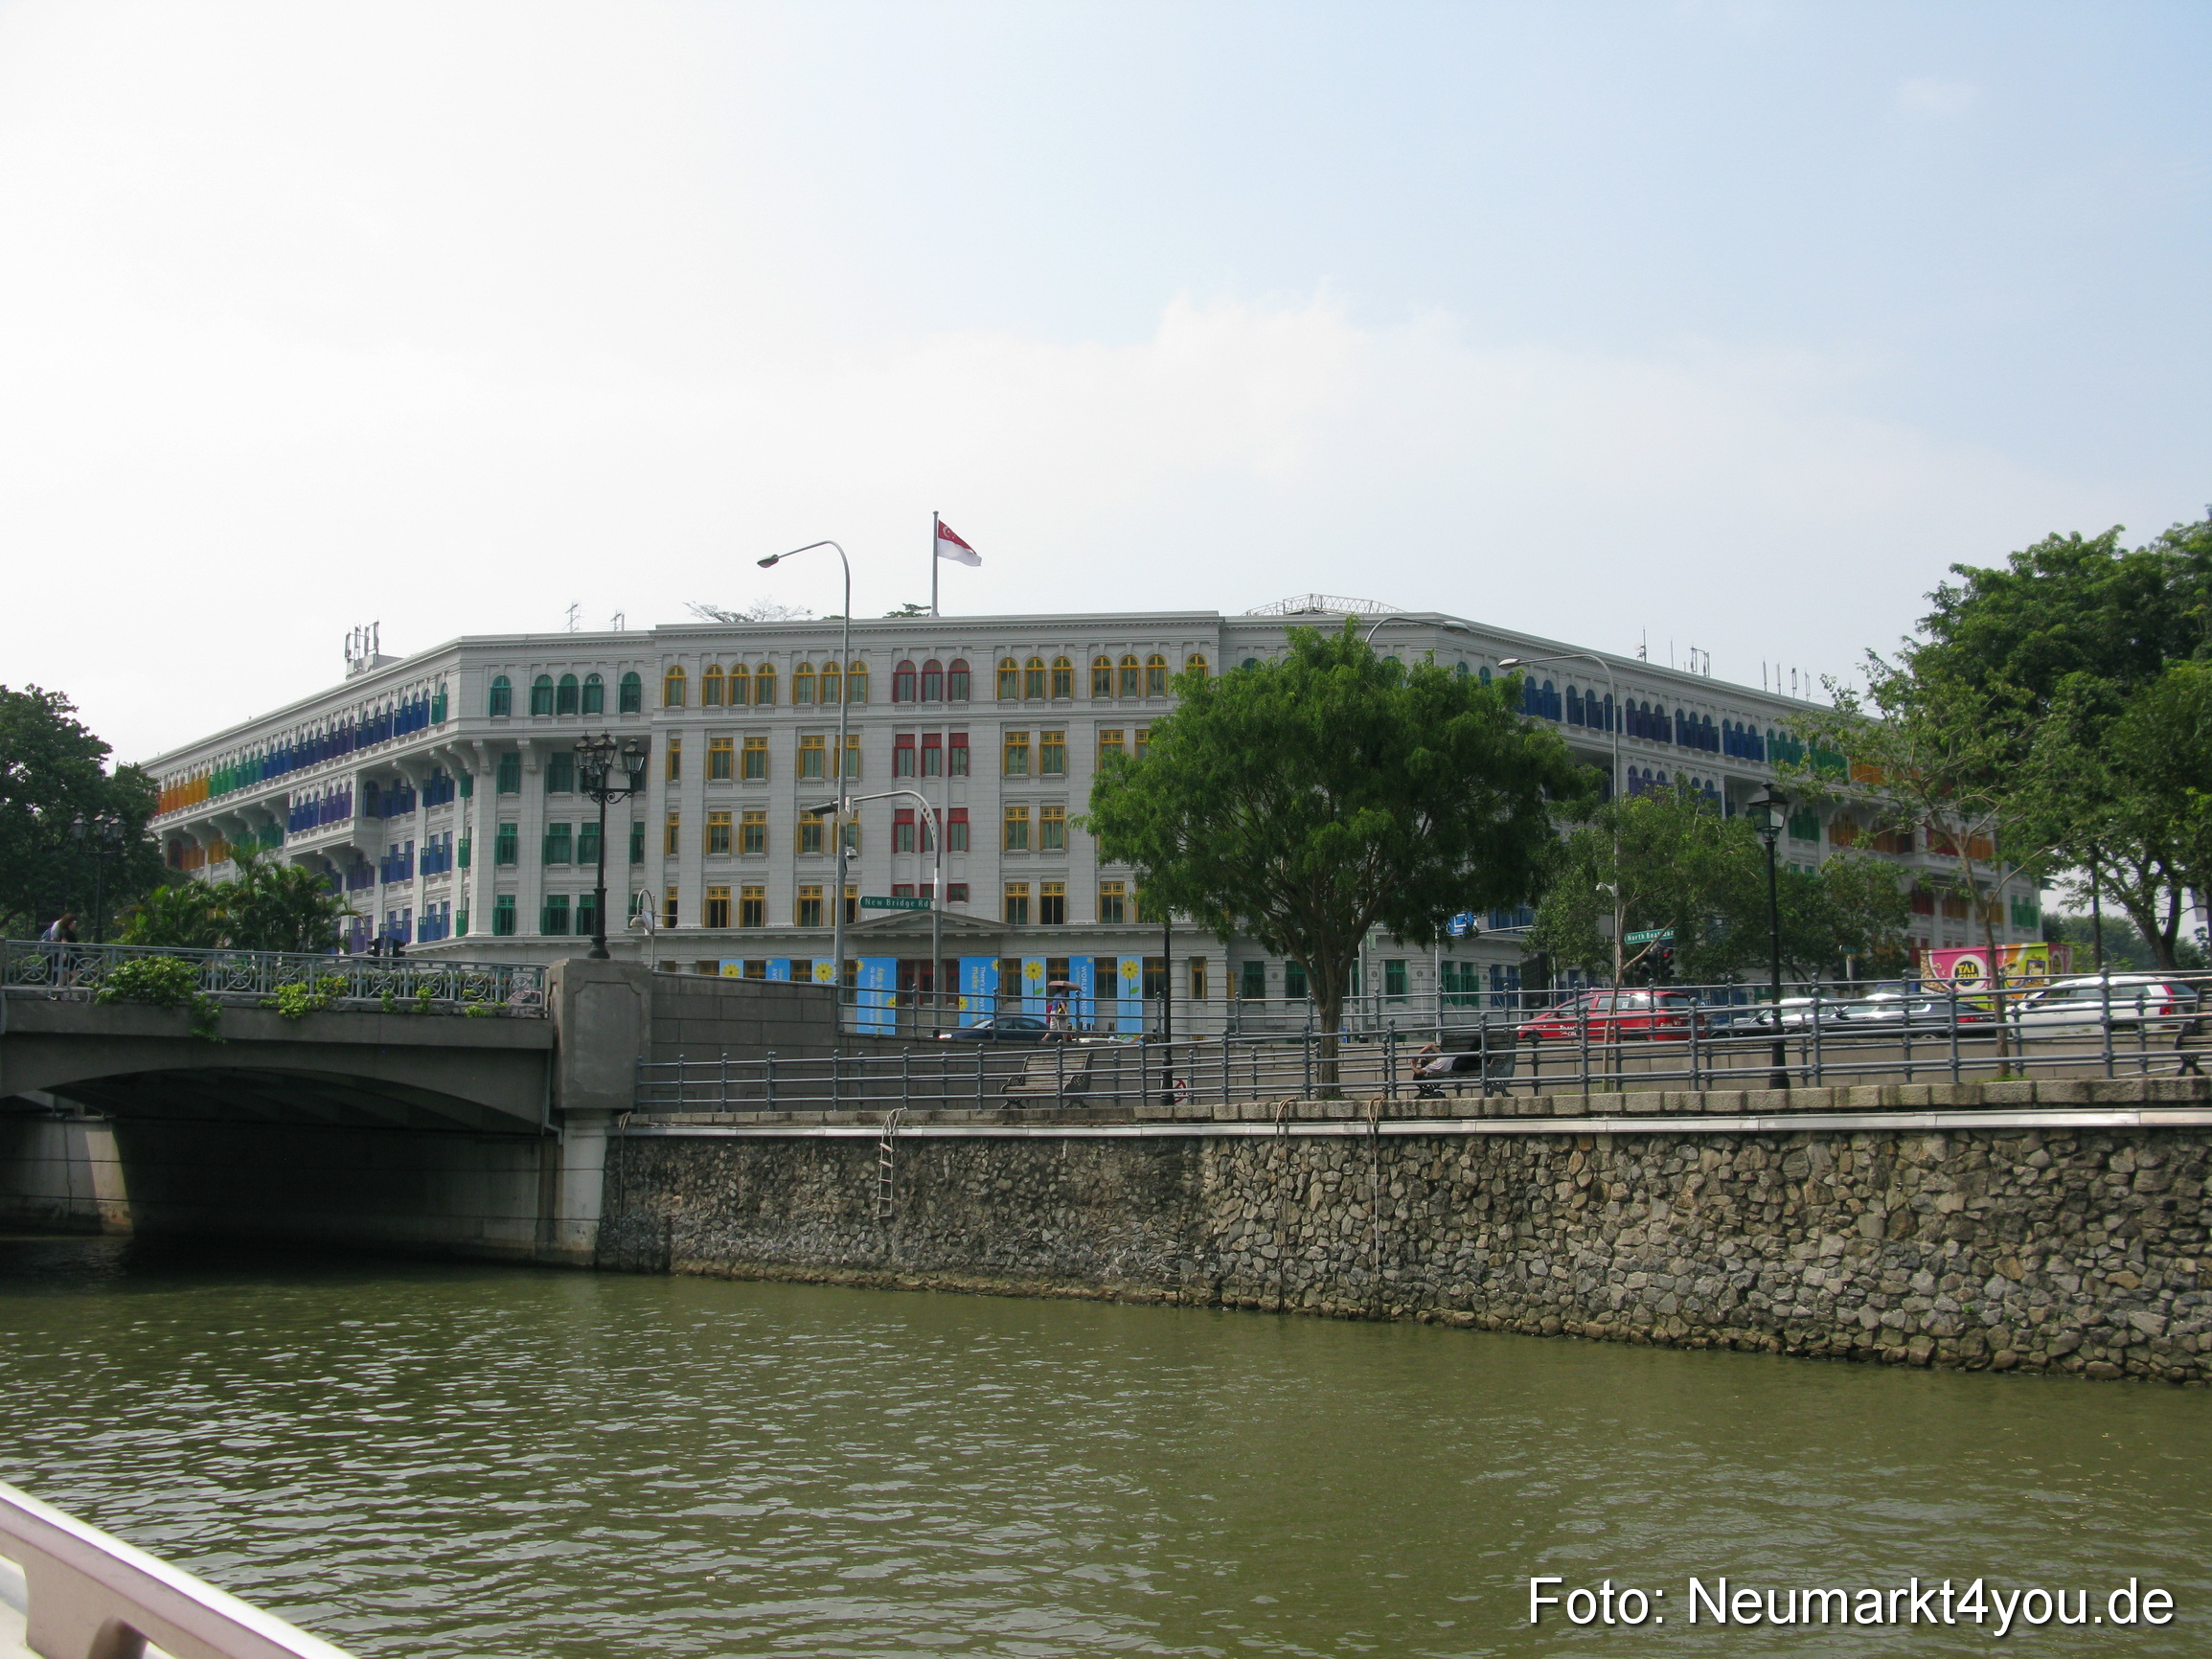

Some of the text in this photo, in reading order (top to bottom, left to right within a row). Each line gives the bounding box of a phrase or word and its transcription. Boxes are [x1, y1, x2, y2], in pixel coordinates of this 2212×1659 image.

[886, 898, 915, 909] Bridge
[1627, 933, 1645, 942] North
[1956, 963, 1976, 973] TAI
[876, 967, 885, 982] day
